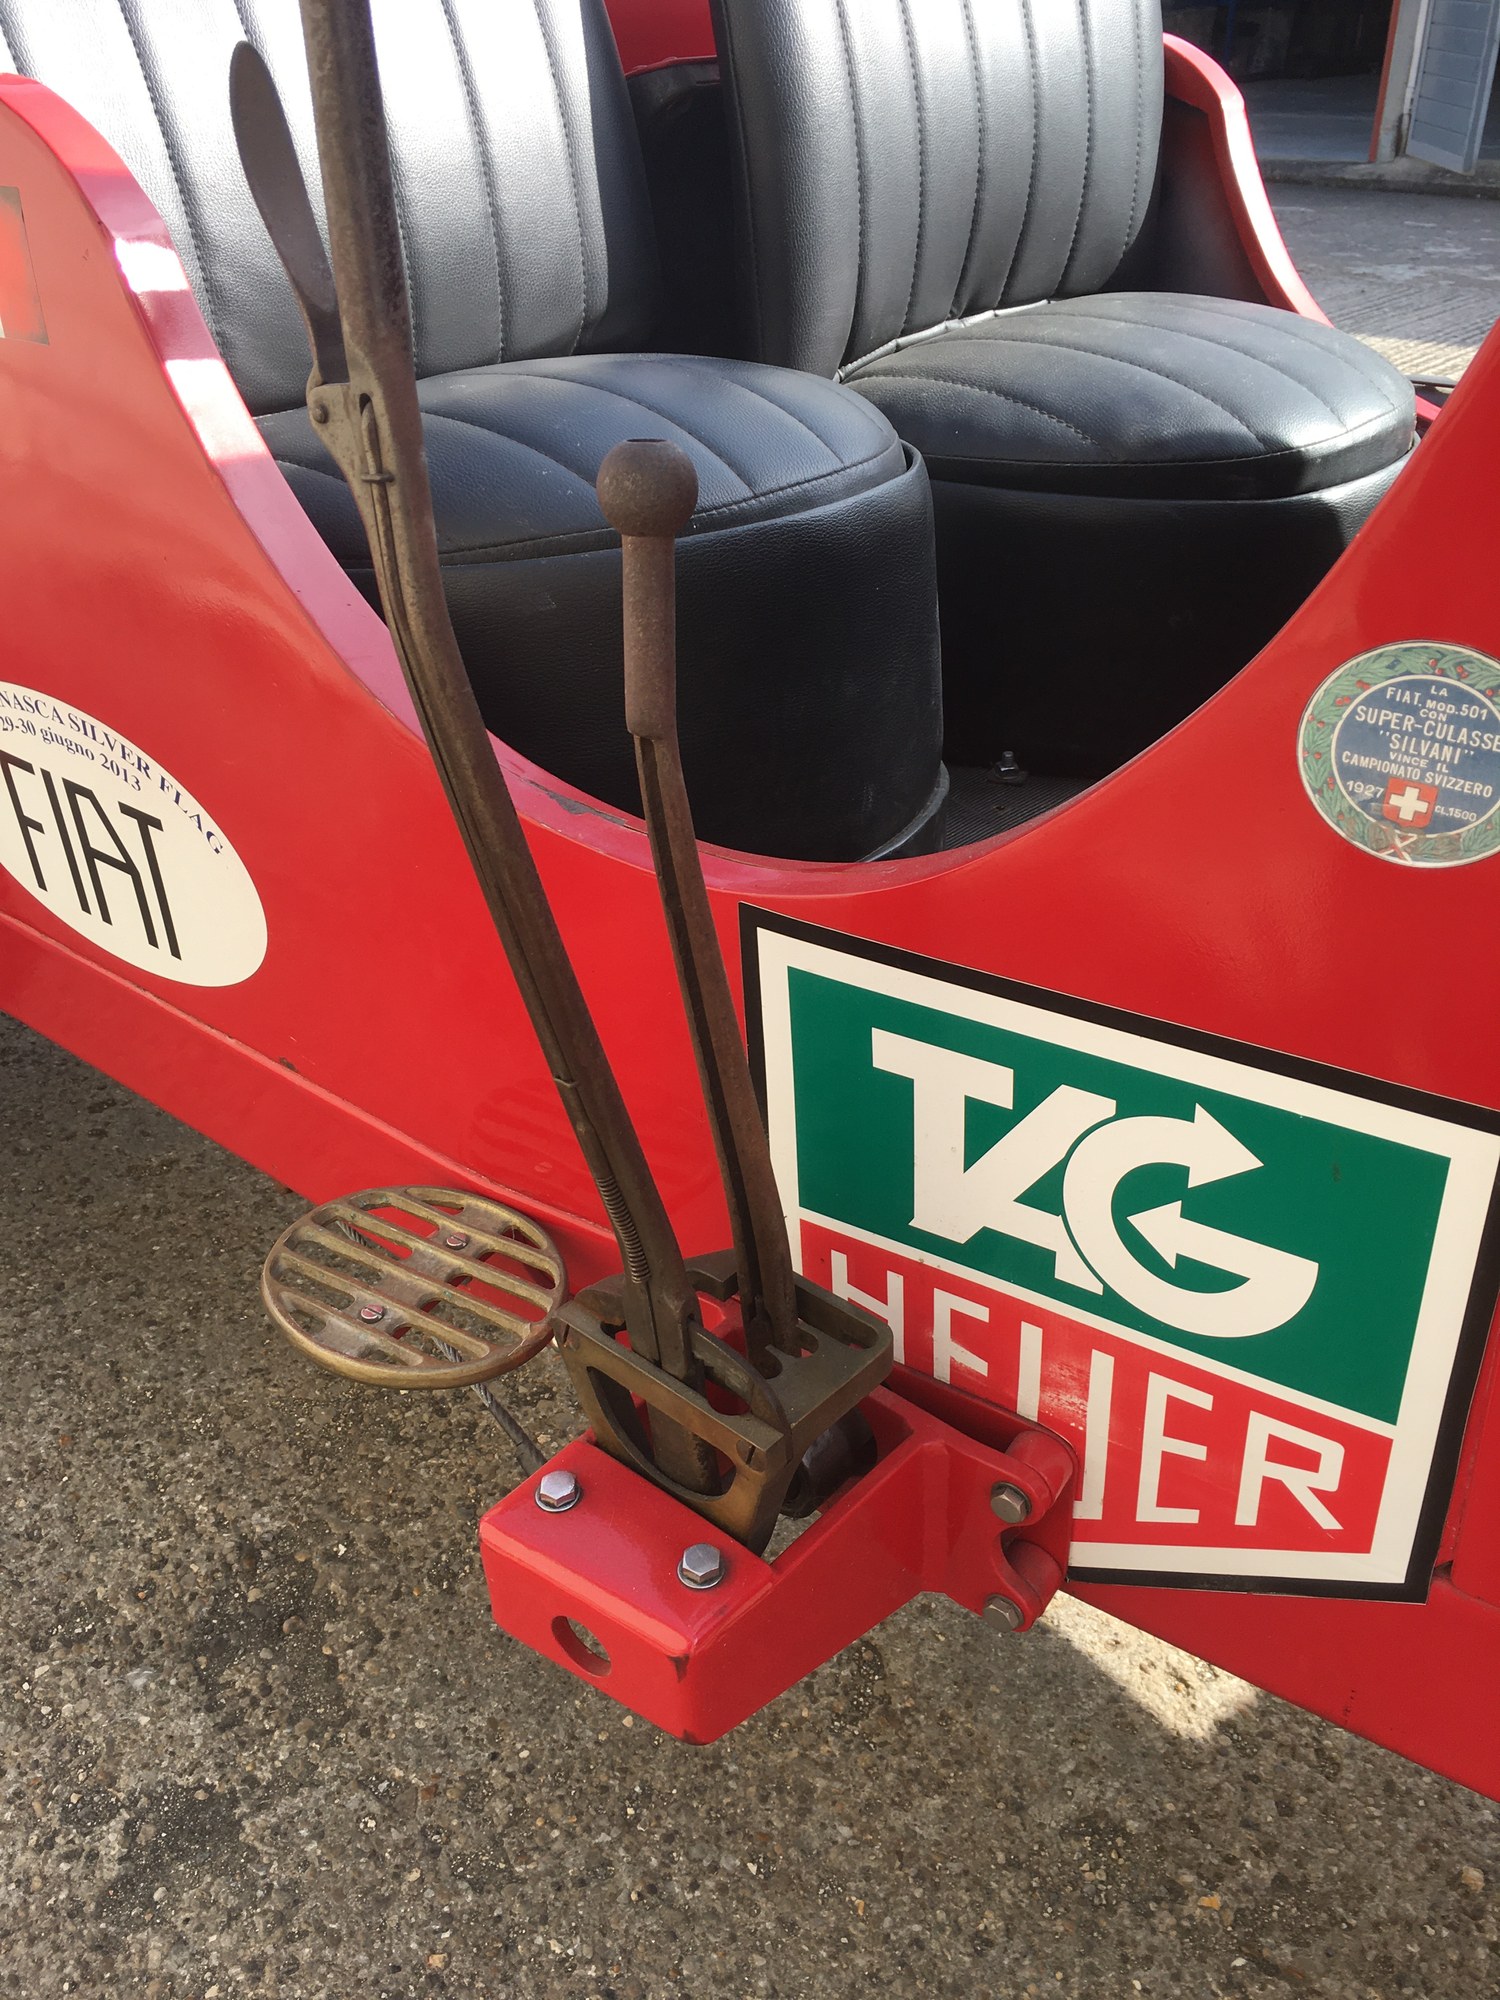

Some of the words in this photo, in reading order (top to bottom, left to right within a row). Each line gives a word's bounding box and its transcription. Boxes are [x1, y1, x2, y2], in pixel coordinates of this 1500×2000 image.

[1386, 687, 1422, 707] FIAT.
[1430, 685, 1448, 697] LA
[1419, 708, 1447, 722] CON
[40, 725, 95, 762] giugno
[99, 753, 142, 792] 2013
[1342, 751, 1420, 780] CAMPIONATO
[1425, 772, 1493, 798] SVIZZERO
[1389, 752, 1428, 768] VINCE
[1436, 764, 1449, 773] IL
[68, 712, 152, 780] SILVER
[159, 774, 224, 855] FLAG
[1346, 780, 1385, 798] 1927
[0, 750, 182, 961] FIAT
[871, 1026, 1319, 1339] TAG
